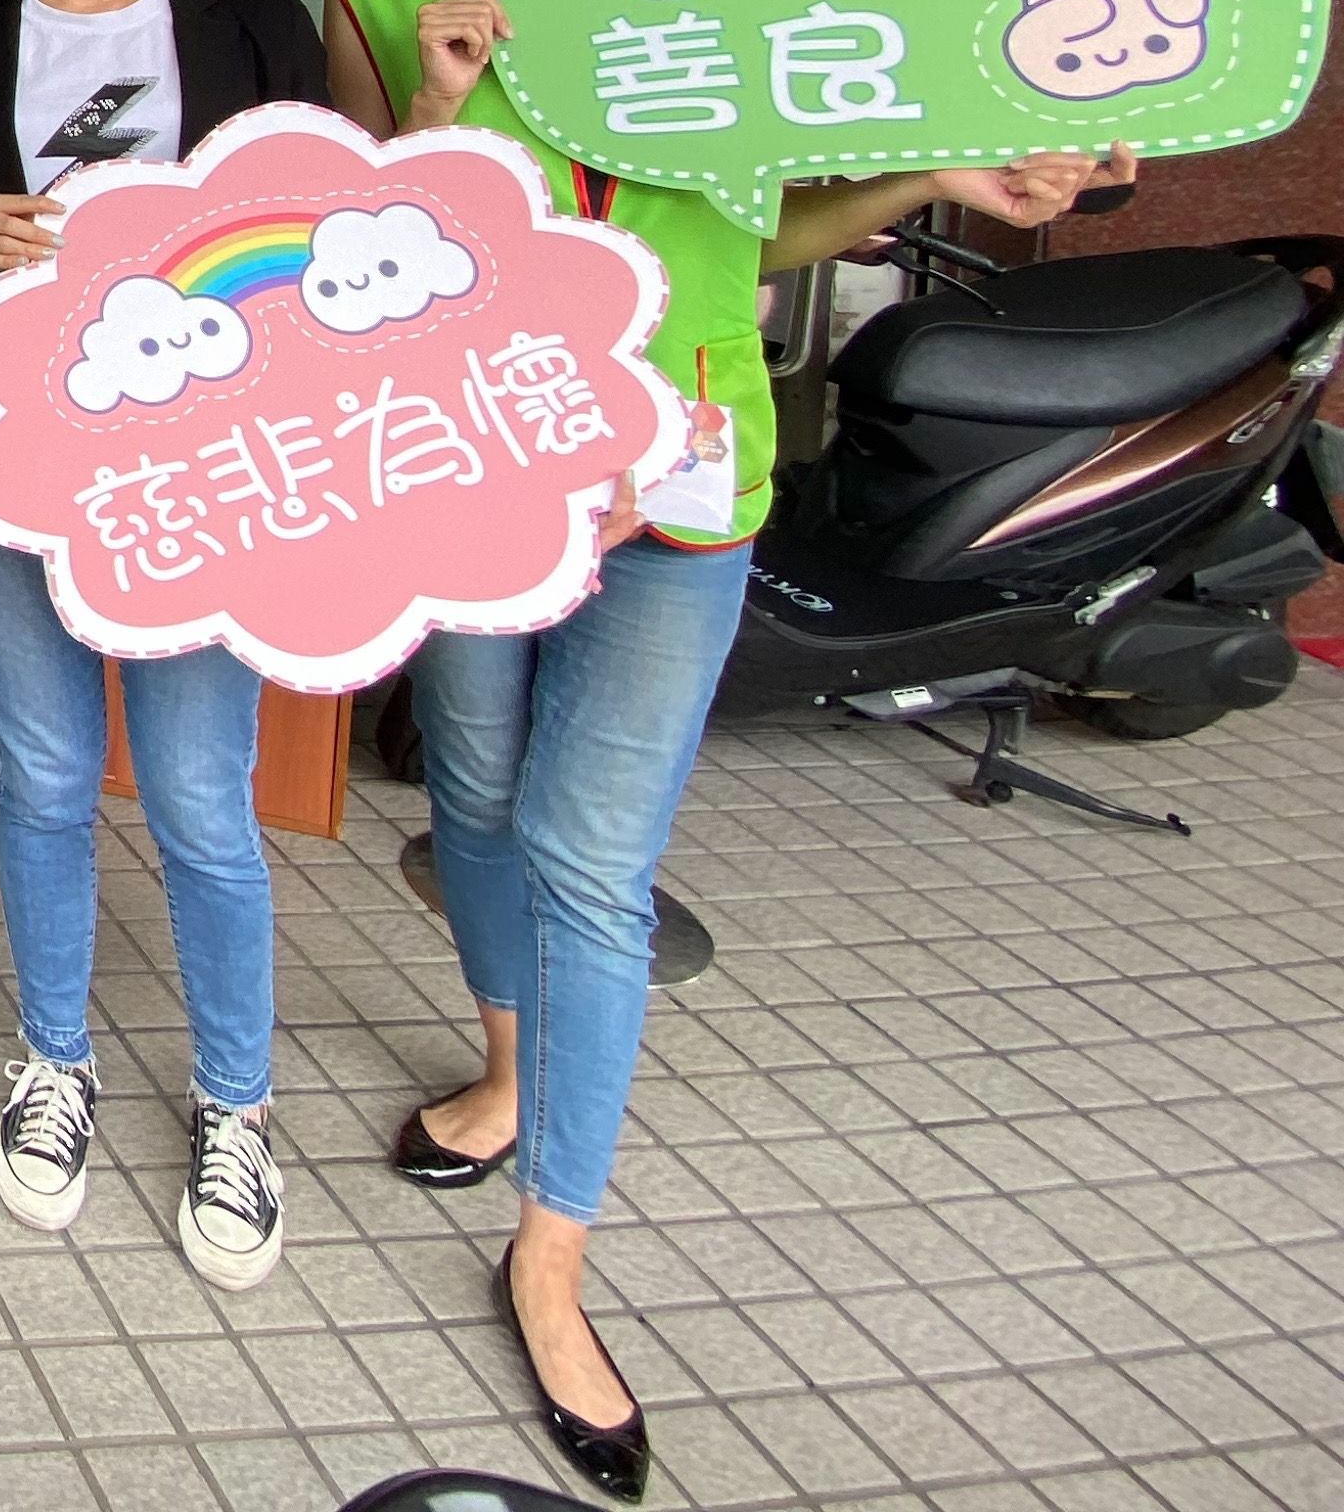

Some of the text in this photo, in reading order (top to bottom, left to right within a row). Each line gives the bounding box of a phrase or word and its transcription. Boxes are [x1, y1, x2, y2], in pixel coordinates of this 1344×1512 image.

[590, 0, 925, 136] 善良
[72, 330, 616, 593] 慈悲為懷
